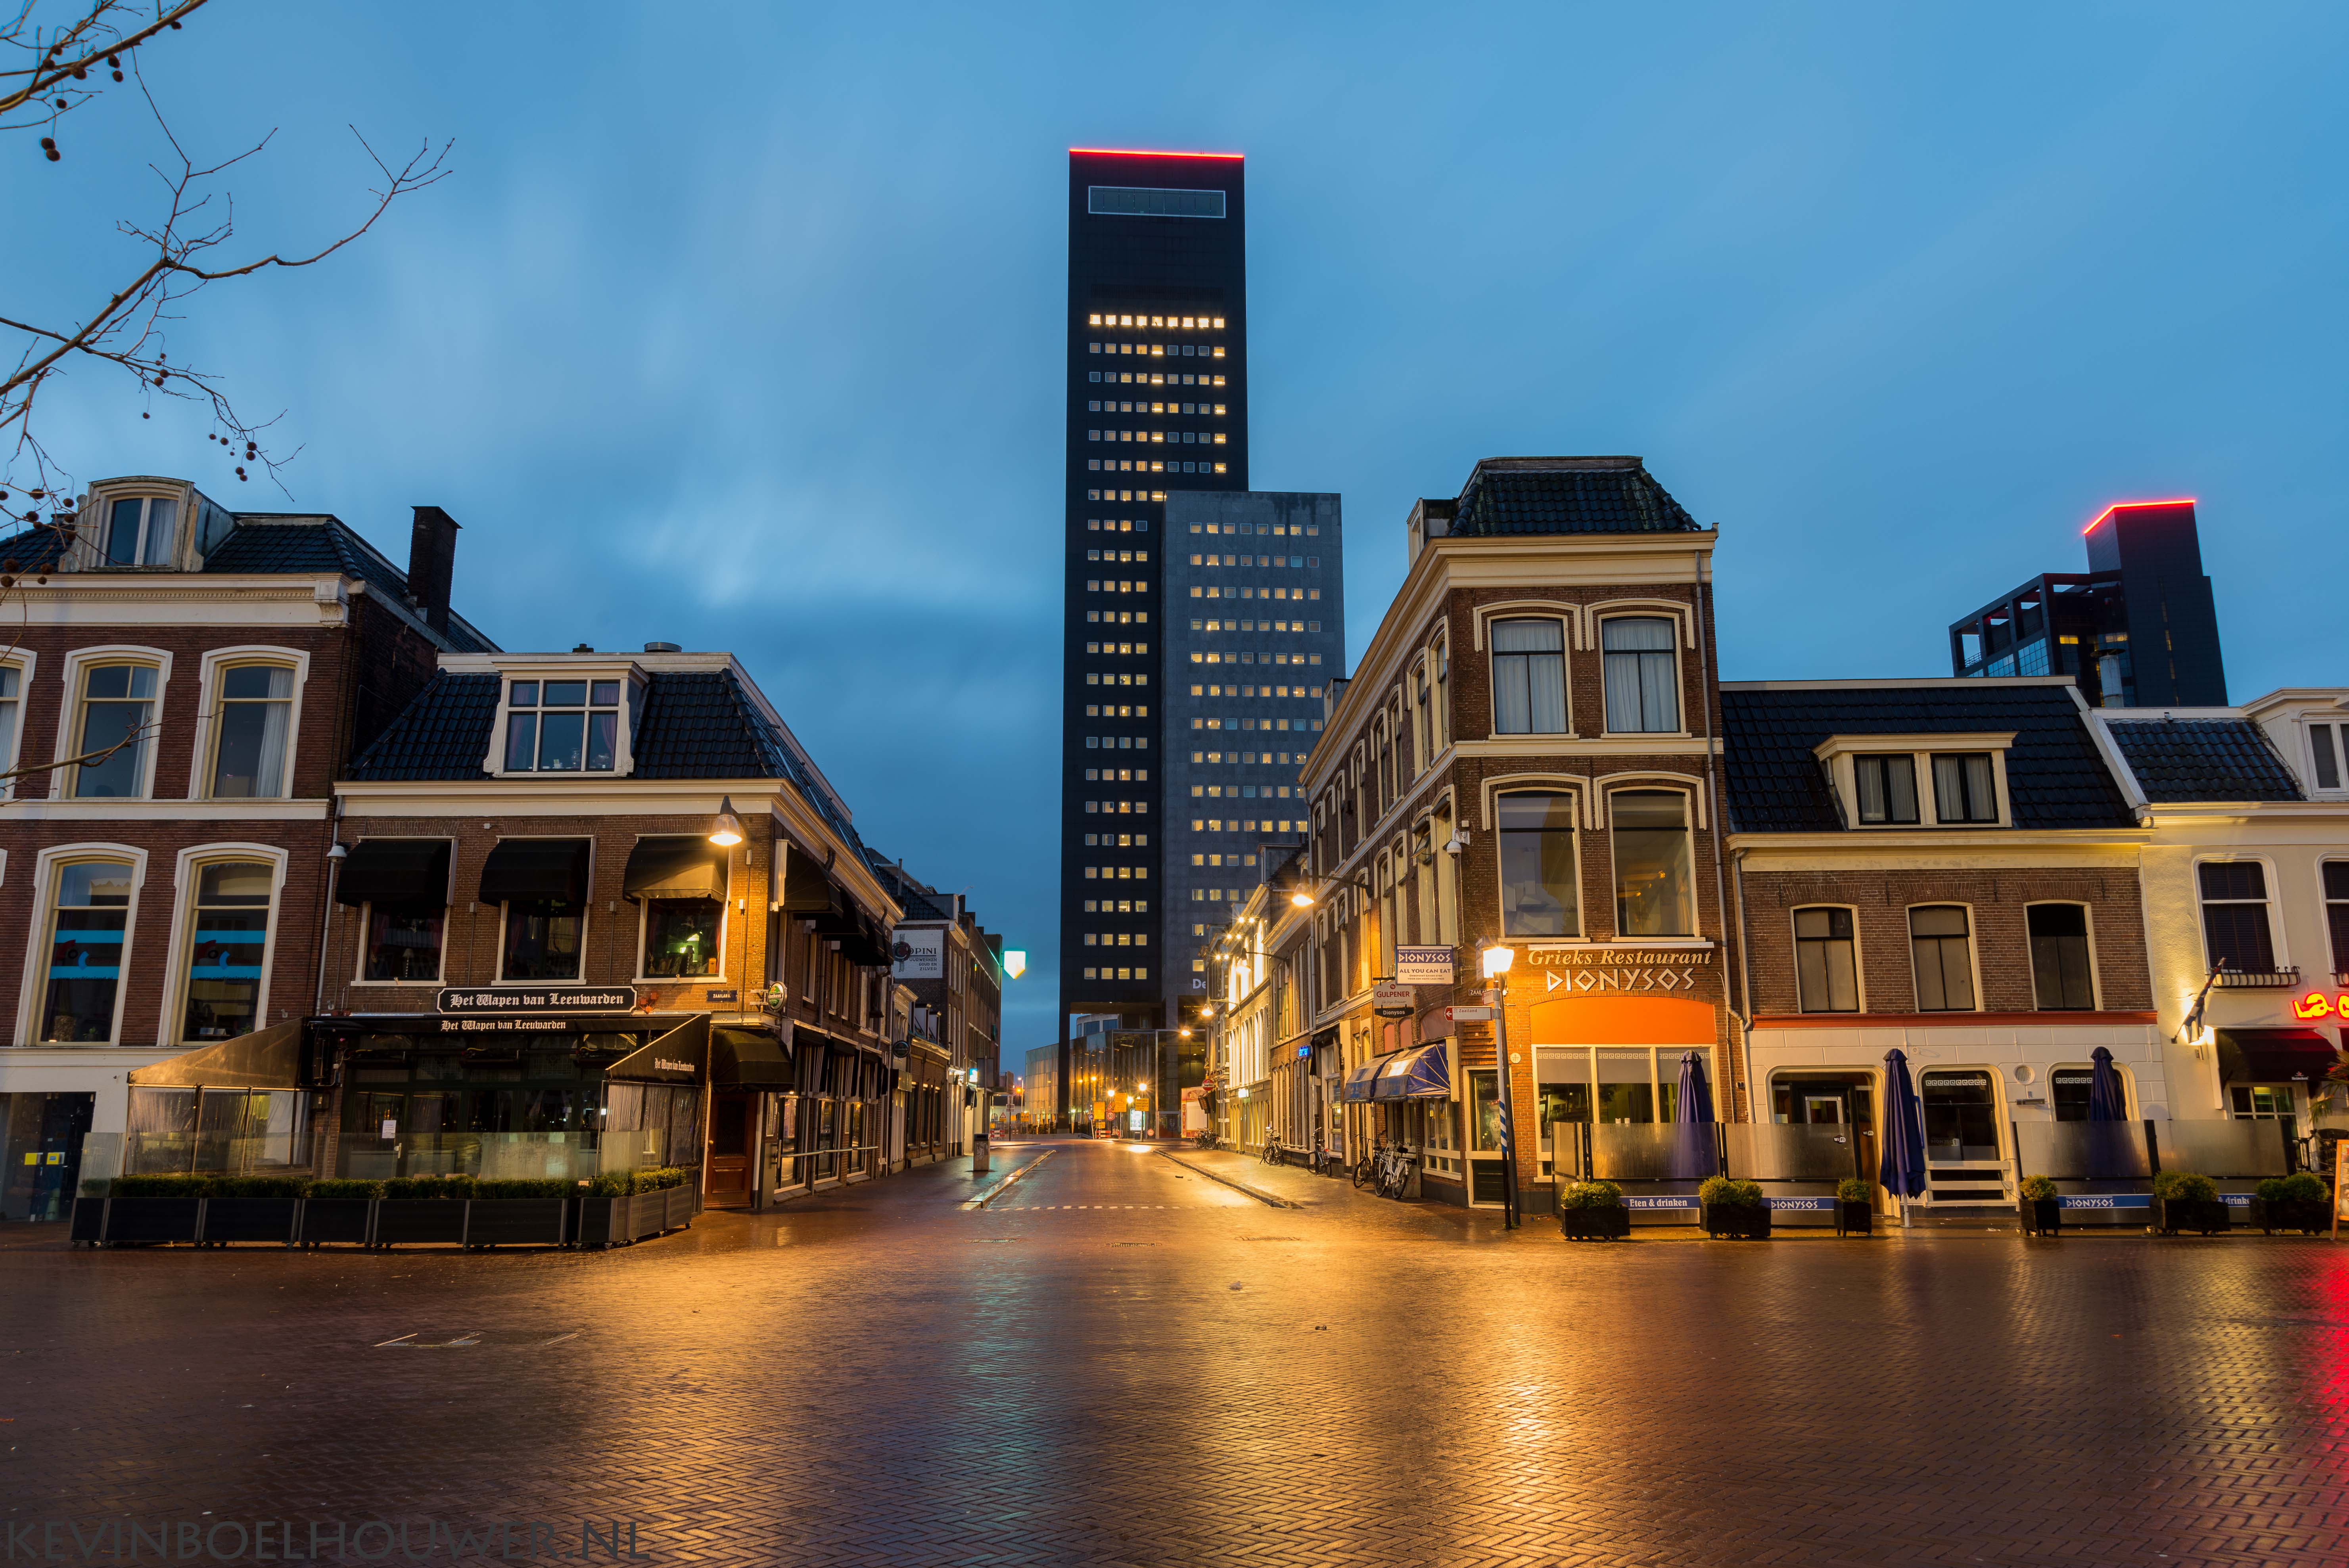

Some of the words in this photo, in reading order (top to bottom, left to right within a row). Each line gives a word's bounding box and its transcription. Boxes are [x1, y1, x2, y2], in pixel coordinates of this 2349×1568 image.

[1398, 953, 1451, 962] DIONYSOS
[1528, 950, 1593, 965] Grieks
[1601, 949, 1712, 964] Restaurant
[1546, 968, 1695, 993] DIONYSOS
[450, 994, 474, 1007] Het
[476, 994, 519, 1007] Wapen
[523, 995, 545, 1005] van
[549, 993, 623, 1005] Leeuwarden
[441, 1020, 459, 1031] Het
[462, 1020, 495, 1031] Wapen
[498, 1021, 512, 1029] van
[514, 1020, 566, 1029] Leeuwarden
[1649, 1198, 1655, 1207] &
[2066, 1199, 2114, 1208] DIONYSOS
